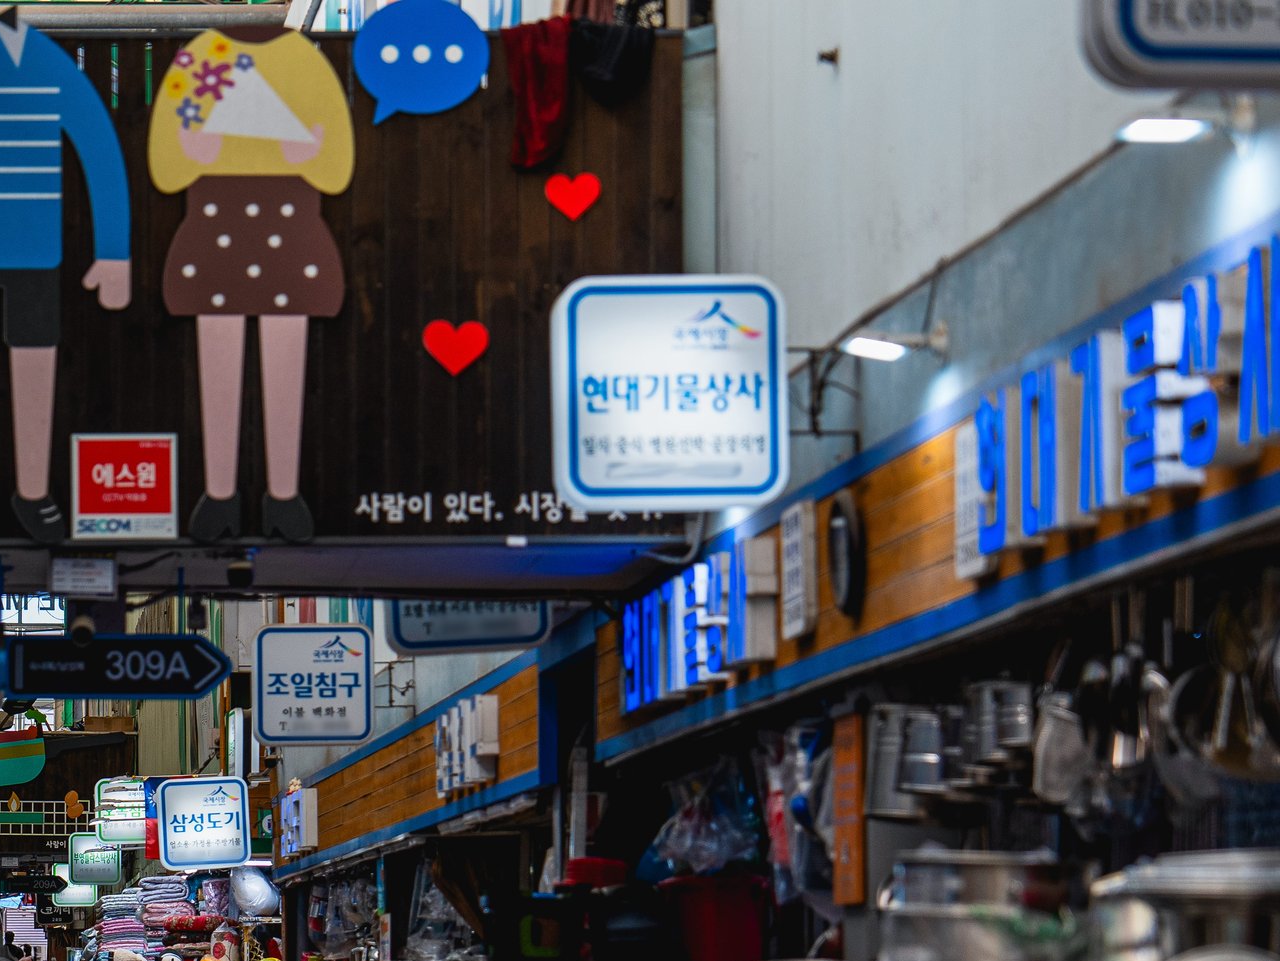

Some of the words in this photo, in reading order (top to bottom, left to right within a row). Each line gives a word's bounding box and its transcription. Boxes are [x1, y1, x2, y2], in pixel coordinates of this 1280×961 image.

[583, 373, 765, 414] 현대기물상사
[91, 461, 157, 488] 에스원
[354, 490, 431, 522] 사람이
[443, 490, 504, 523] 있다.
[77, 519, 131, 533] SECOM
[313, 649, 344, 659] 국제시장
[105, 651, 191, 681] 309A
[267, 672, 362, 698] 조일침구
[282, 707, 305, 717] 이불
[312, 706, 347, 717] 백화점
[170, 811, 241, 833] 삼성도기
[46, 840, 67, 849] 사람이
[74, 852, 117, 864] 부영플라스틱상사
[33, 881, 57, 889] 209A
[41, 907, 71, 915] 코끼리
